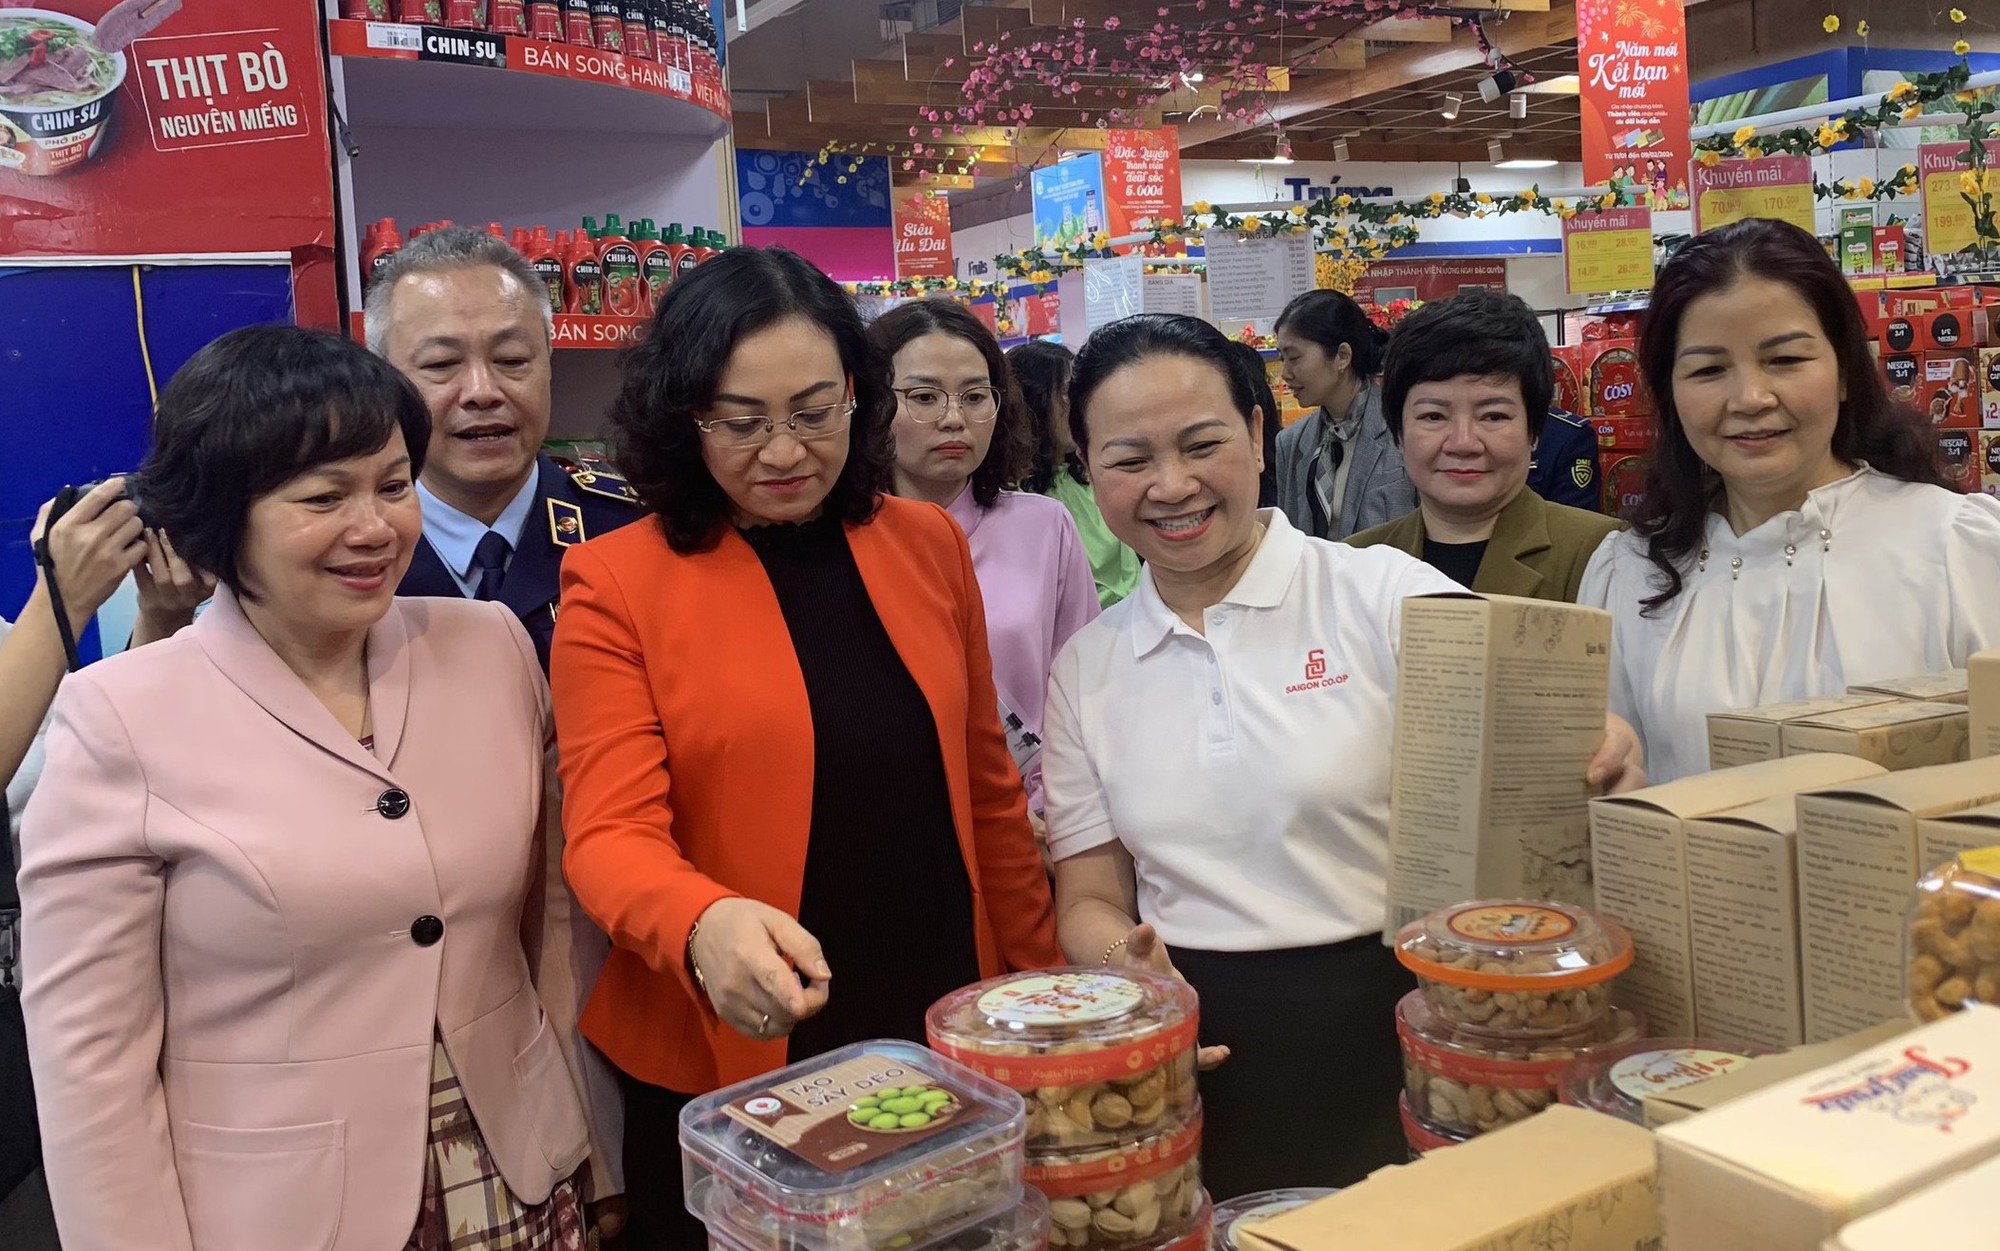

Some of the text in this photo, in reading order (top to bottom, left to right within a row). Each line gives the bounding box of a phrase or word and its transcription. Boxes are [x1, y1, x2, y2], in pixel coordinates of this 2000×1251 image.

[426, 35, 497, 60] CHIN-SU
[1616, 40, 1679, 59] Năm mới
[524, 45, 569, 70] BÁN
[576, 55, 627, 80] SONG
[1588, 53, 1669, 90] Kết bạn
[146, 42, 289, 105] THỊT BÒ
[1619, 81, 1646, 98] mới
[31, 100, 101, 131] CHIN-SU
[159, 100, 297, 139] NGUYÊN MIẾNG
[1698, 164, 1782, 188] Khuyến mãi
[903, 222, 934, 237] Siêu
[1609, 214, 1628, 228] mãi
[534, 263, 561, 273] CHIN-SU
[606, 253, 636, 264] CHIN-SU
[1371, 268, 1394, 279] NHẬP
[1396, 266, 1423, 277] THÀNH
[1423, 265, 1442, 275] VIÊN
[1604, 382, 1634, 401] COSY
[1598, 425, 1614, 434] COSY
[1285, 680, 1320, 694] SAIGON
